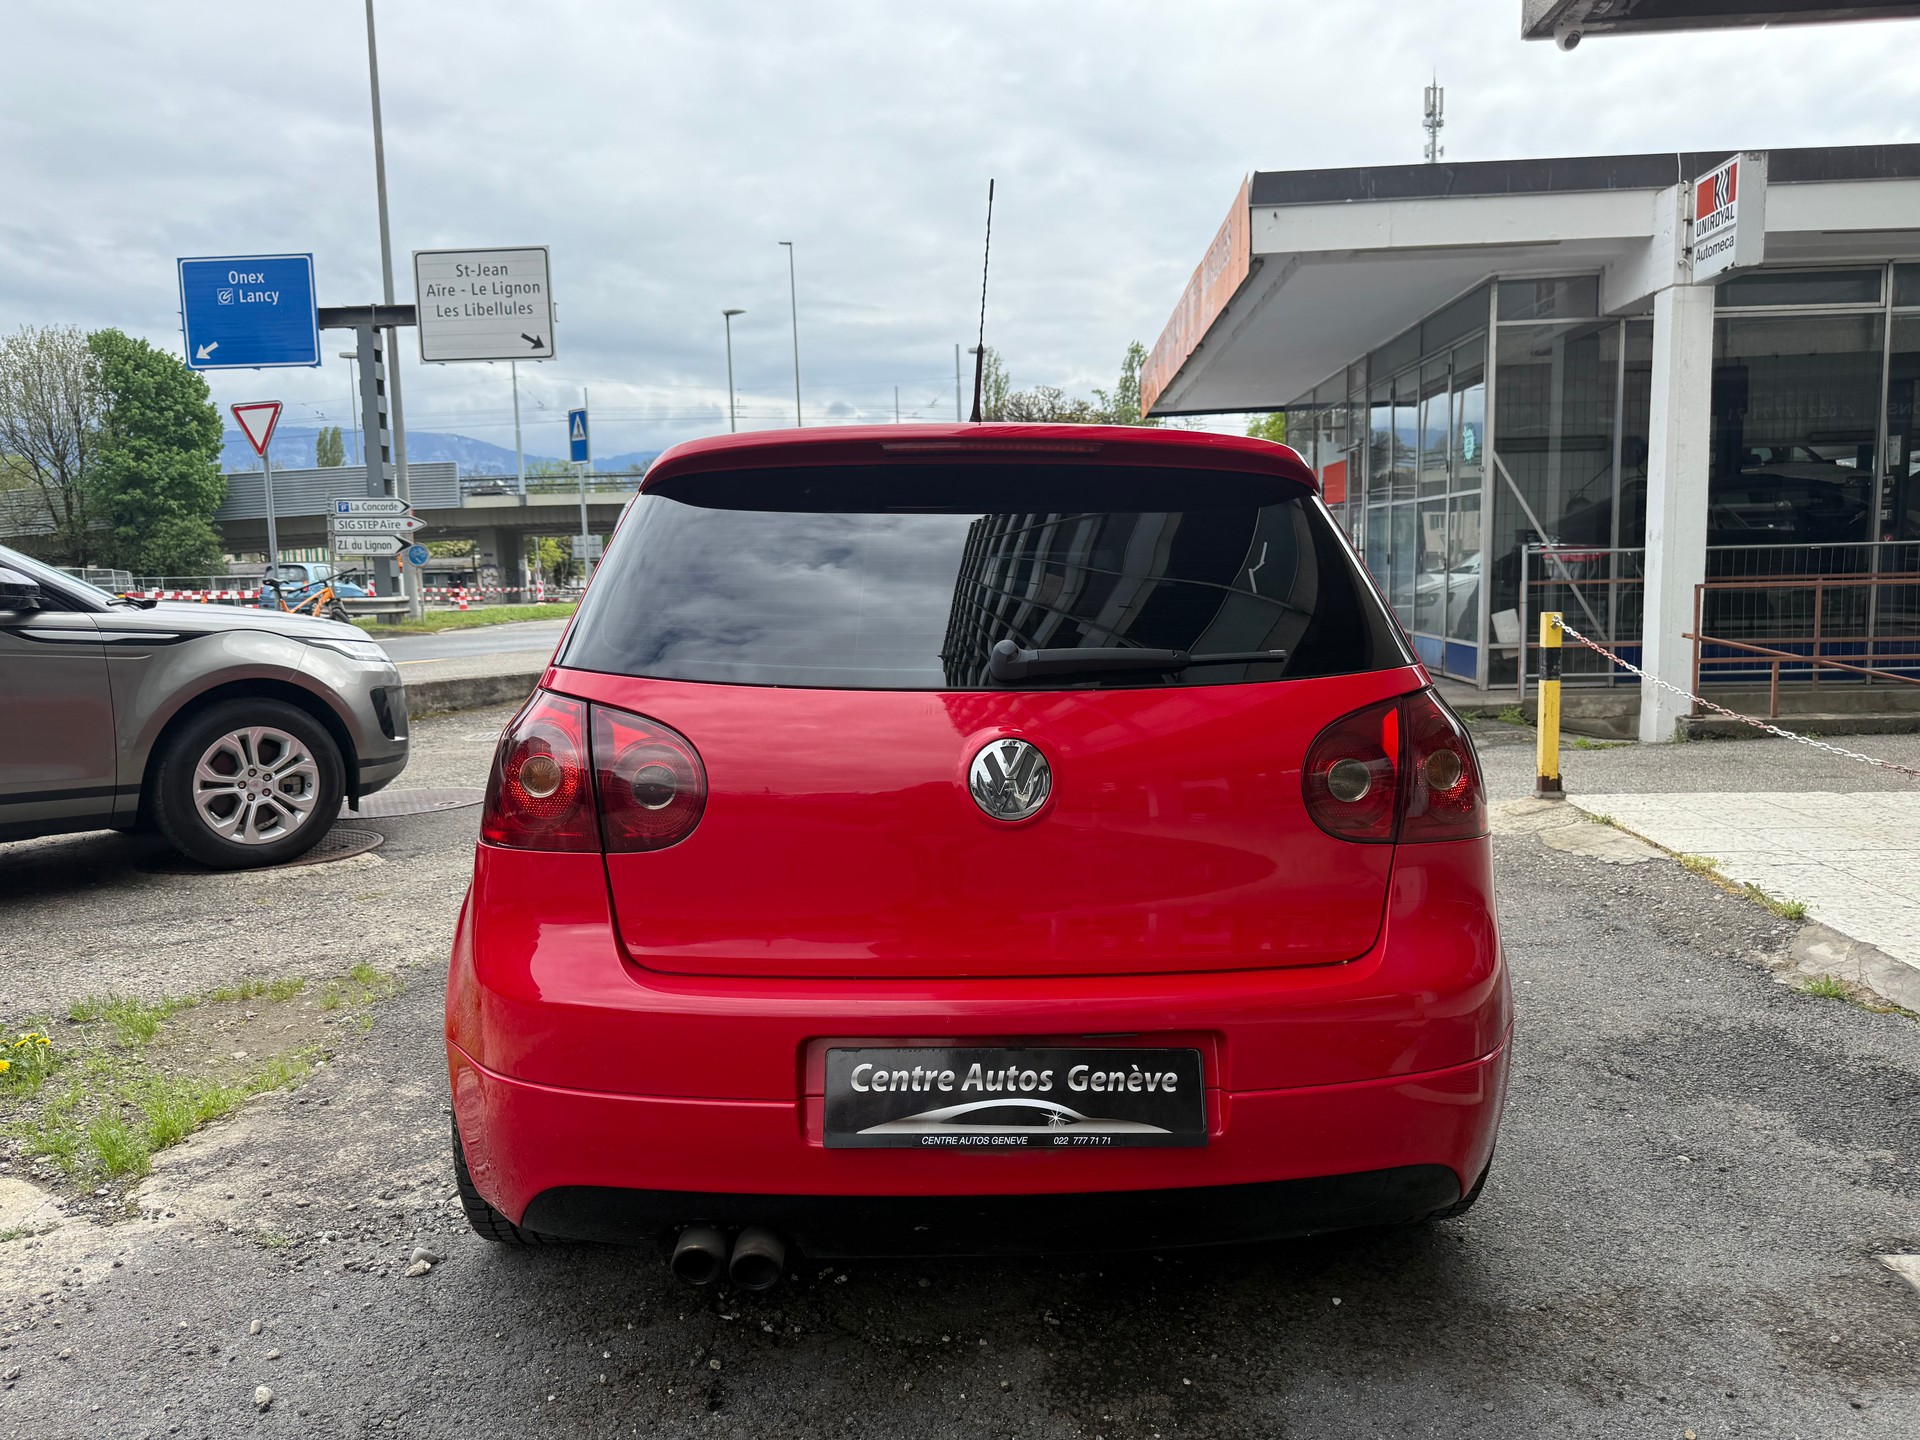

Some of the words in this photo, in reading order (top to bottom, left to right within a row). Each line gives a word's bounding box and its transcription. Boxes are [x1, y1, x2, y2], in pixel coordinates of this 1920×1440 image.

[1696, 204, 1735, 238] UNIROYAL
[1695, 235, 1734, 264] Automeca
[228, 270, 265, 285] Onex
[455, 263, 509, 278] St-Jean
[239, 289, 280, 305] Lancy
[426, 283, 456, 298] Aïre
[471, 282, 487, 296] Le
[492, 281, 541, 298] Lignon
[436, 304, 460, 318] Les
[464, 301, 534, 317] Libellules
[350, 502, 360, 511] La
[361, 502, 399, 511] Concorde
[338, 520, 356, 530] SIG
[357, 520, 379, 529] STEP
[380, 519, 401, 529] Aïre
[351, 540, 362, 550] du
[364, 540, 392, 552] Lignon
[850, 1062, 956, 1093] Centre
[960, 1062, 1054, 1093] Autos
[1067, 1063, 1179, 1093] Genève
[921, 1136, 958, 1145] CENTRE
[958, 1136, 990, 1145] AUTOS
[991, 1136, 1029, 1145] GENEVE
[1053, 1136, 1069, 1145] 022
[1073, 1136, 1089, 1145] 777
[1090, 1136, 1099, 1145] 71
[1101, 1136, 1111, 1145] 71
